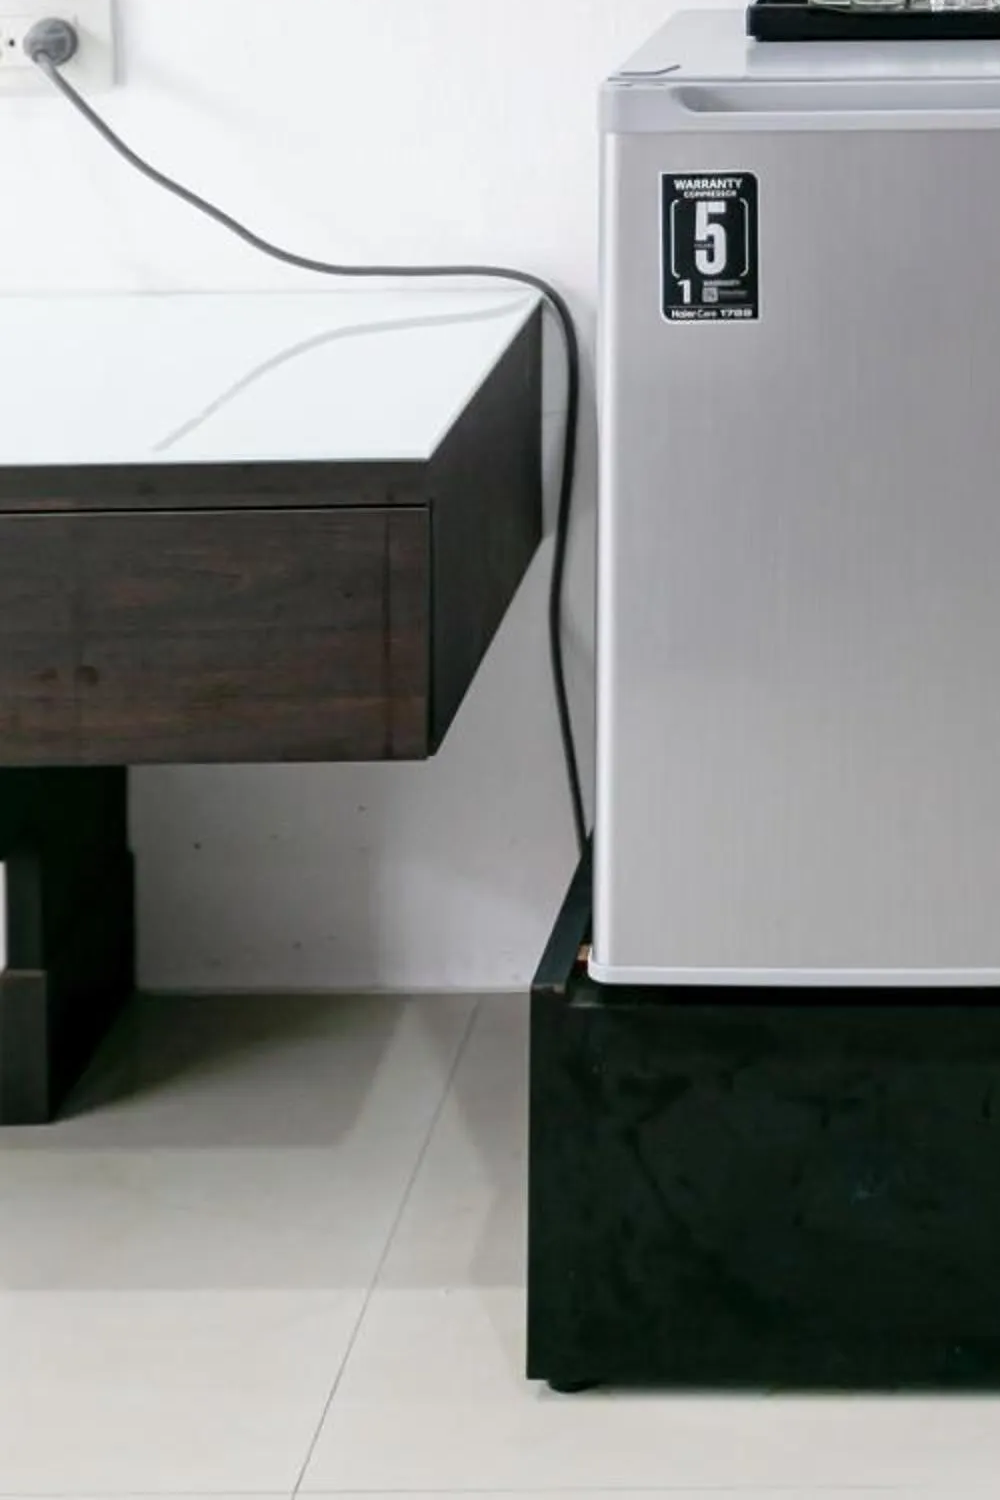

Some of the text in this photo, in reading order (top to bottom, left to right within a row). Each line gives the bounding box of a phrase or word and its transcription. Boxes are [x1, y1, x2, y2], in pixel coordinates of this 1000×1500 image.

[673, 177, 743, 190] WARRANTY
[695, 200, 727, 276] 5
[677, 278, 691, 304] 1
